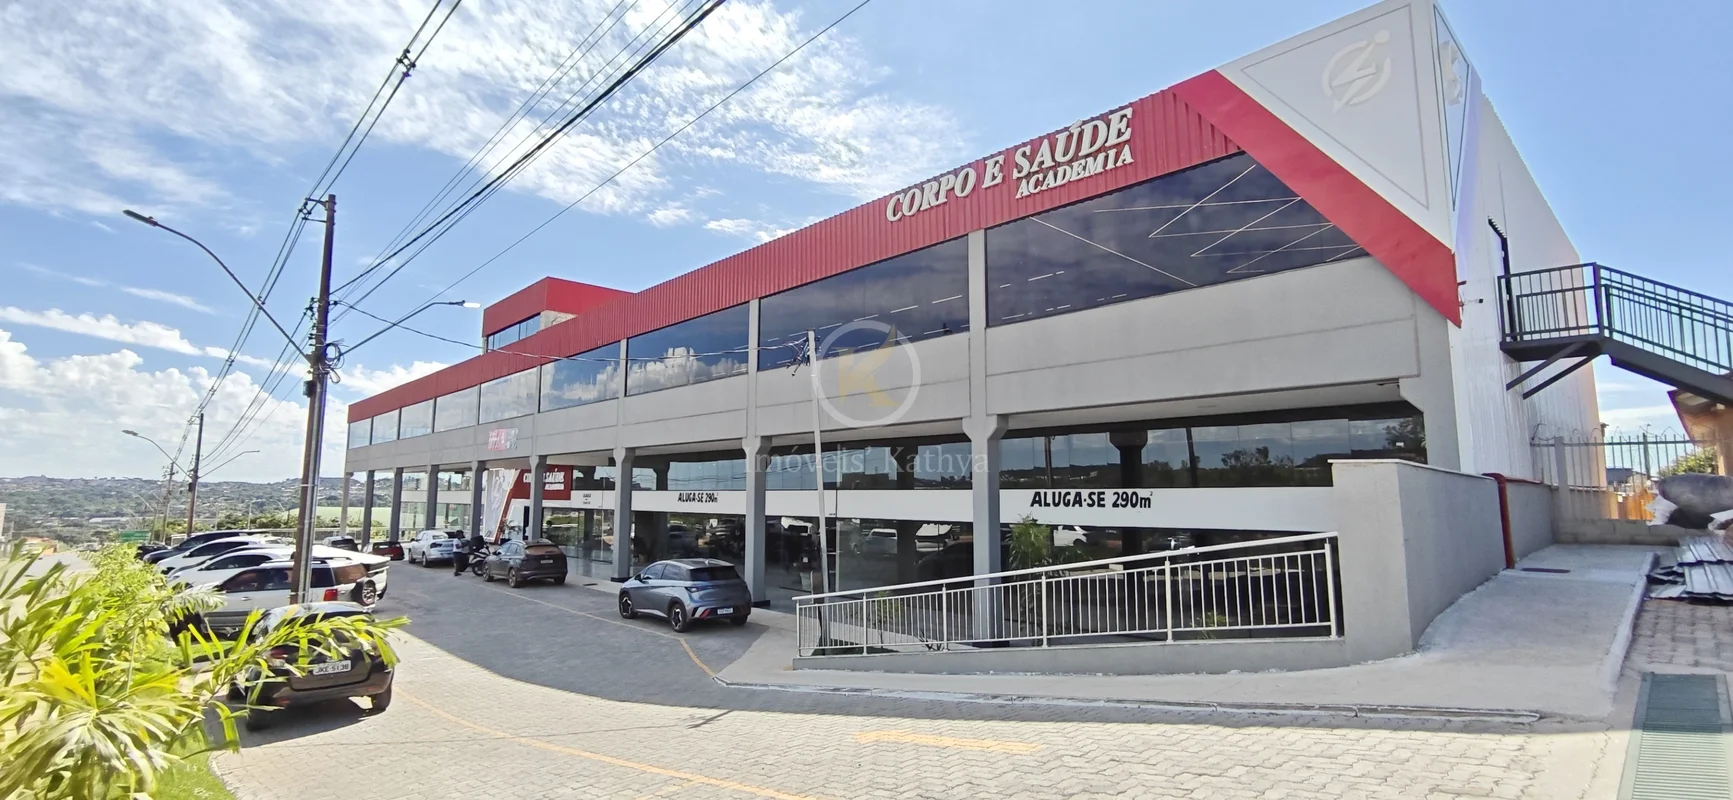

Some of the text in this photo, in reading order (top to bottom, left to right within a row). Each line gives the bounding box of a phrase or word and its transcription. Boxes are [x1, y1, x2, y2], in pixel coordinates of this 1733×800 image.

[886, 107, 1133, 222] CORPO E SAÚDE
[1015, 144, 1134, 199] ACADEMIA
[1030, 491, 1106, 508] ALUGA-SE
